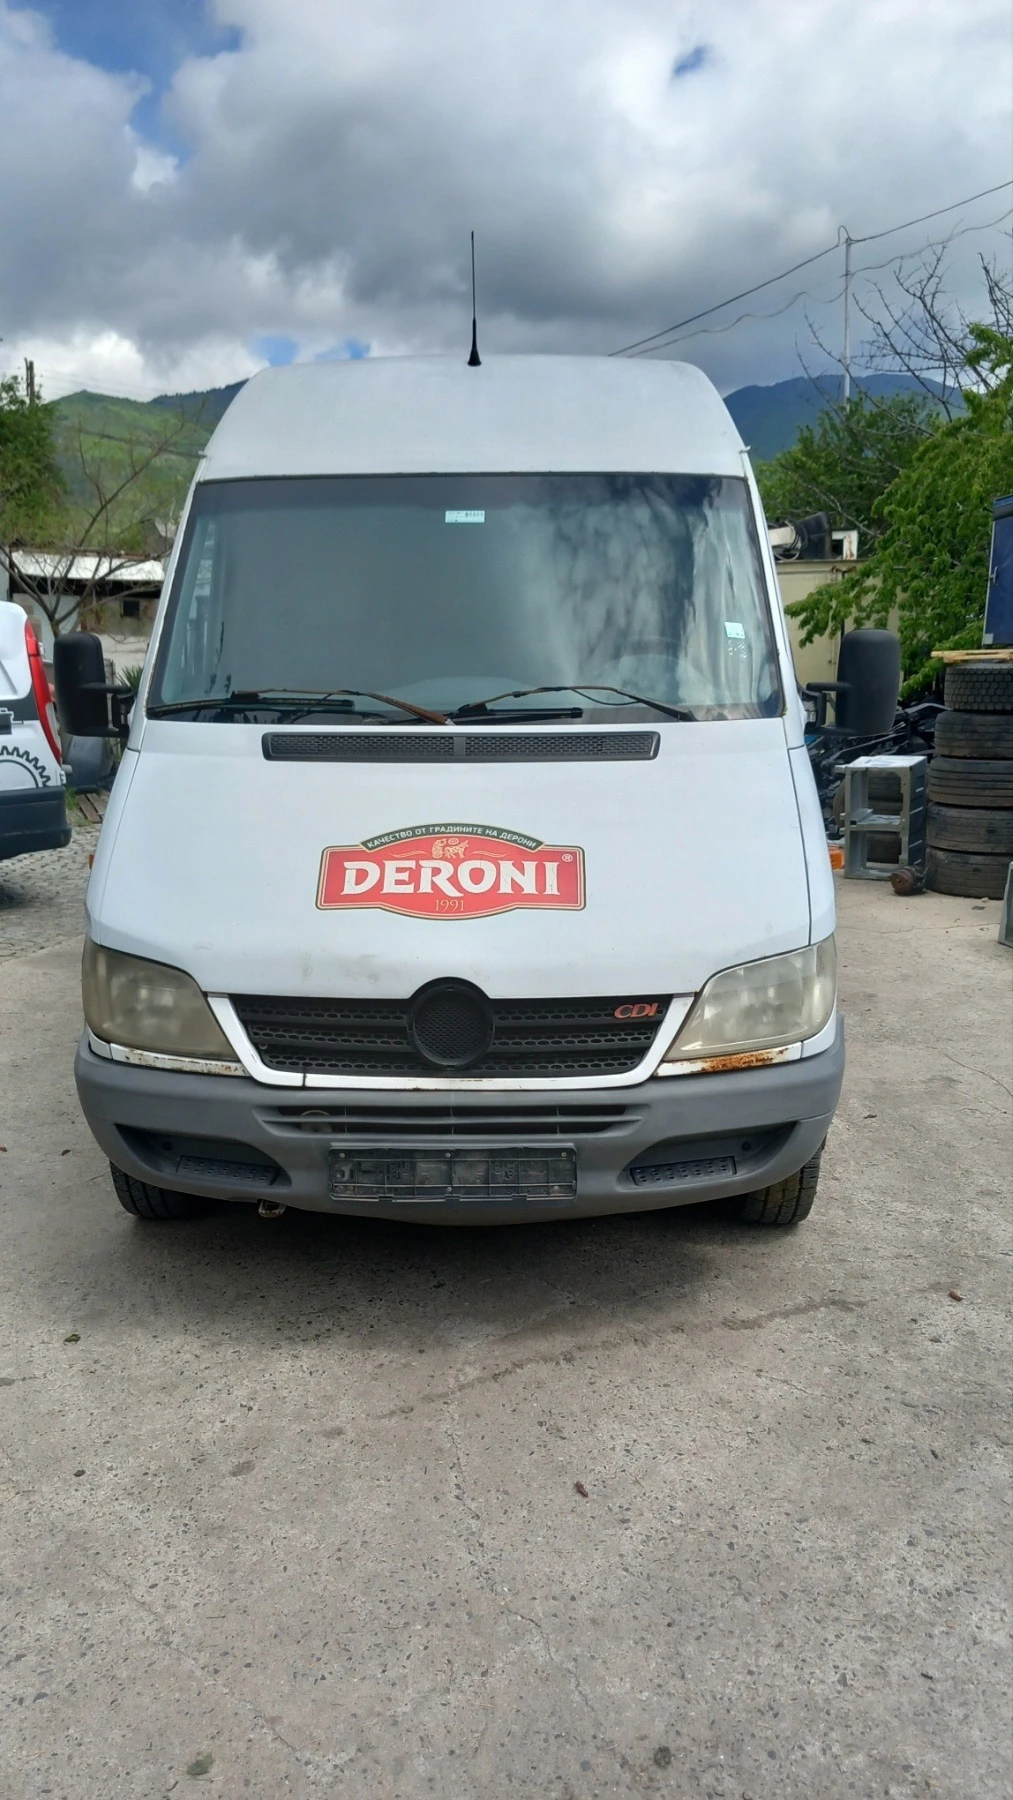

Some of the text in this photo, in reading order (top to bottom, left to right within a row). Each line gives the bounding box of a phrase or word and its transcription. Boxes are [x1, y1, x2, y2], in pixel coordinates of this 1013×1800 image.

[367, 829, 413, 848] КАЧЕСТВО
[429, 825, 483, 834] ГРАДИНИТЕ
[485, 829, 498, 837] НА
[501, 832, 537, 848] ДЕРОНИ
[340, 859, 560, 897] DERONI
[435, 900, 464, 912] 1991
[614, 1003, 658, 1019] CDI
